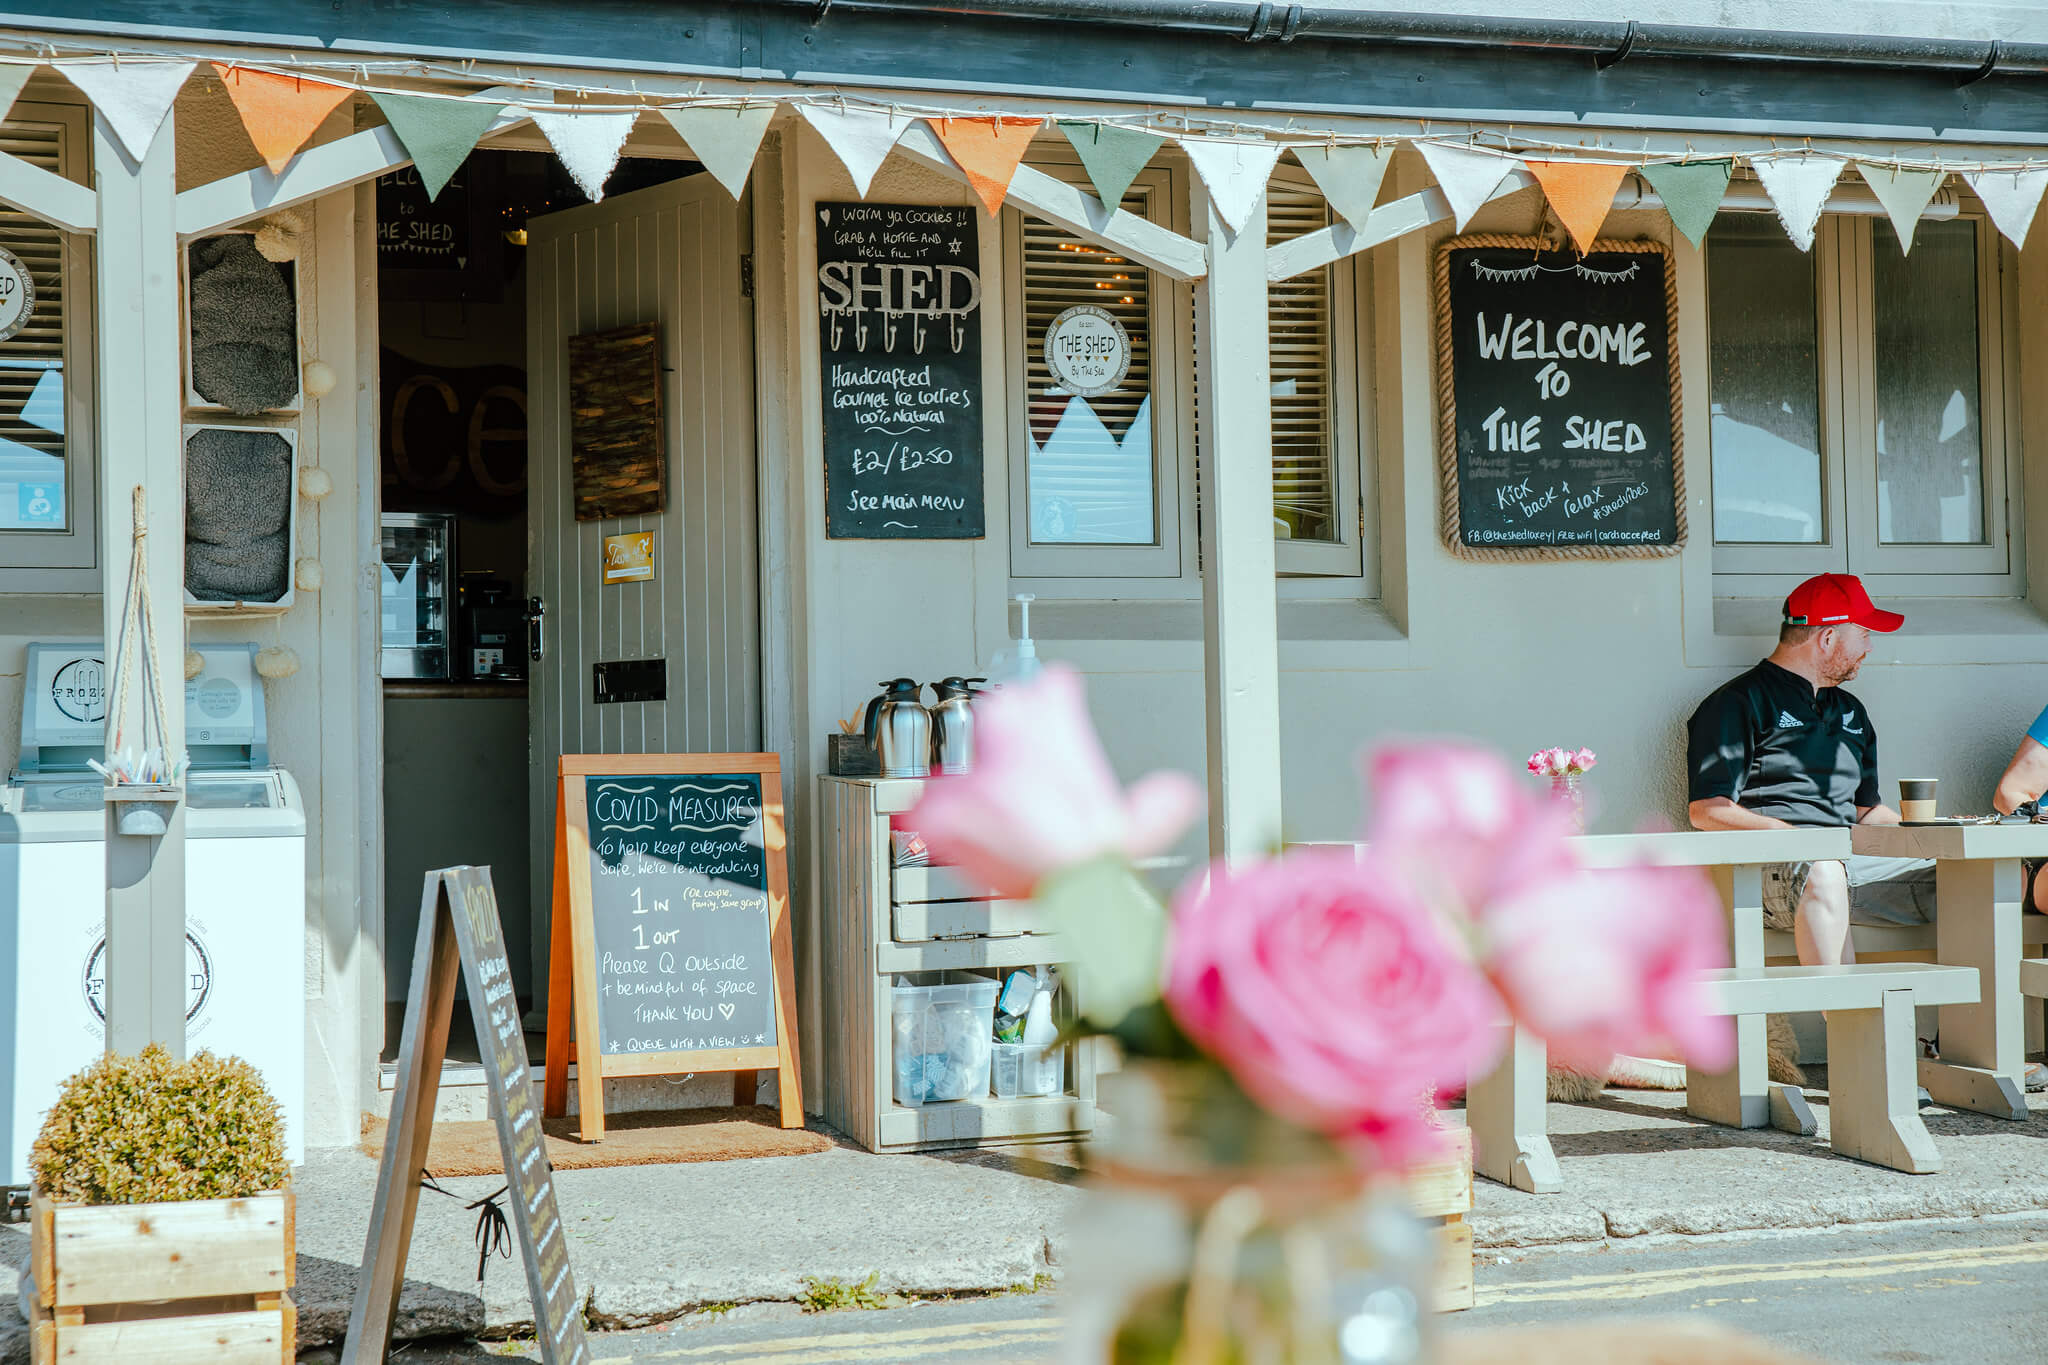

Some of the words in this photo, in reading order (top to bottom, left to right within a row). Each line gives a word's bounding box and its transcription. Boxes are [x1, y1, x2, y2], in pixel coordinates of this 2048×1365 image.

[401, 202, 414, 215] to
[886, 212, 903, 227] ya
[906, 210, 952, 223] Cockles
[408, 221, 452, 240] SHED
[834, 230, 864, 245] GRAB
[869, 233, 876, 243] A
[883, 232, 919, 244] HOTTIE
[921, 233, 942, 244] AND
[819, 261, 981, 314] SHED
[1059, 334, 1082, 353] THE
[1085, 334, 1115, 353] SHED
[1477, 312, 1652, 366] WELCOME
[832, 365, 930, 389] Handcrafted
[1535, 362, 1570, 400] TO
[833, 390, 889, 408] Gourmet
[895, 391, 916, 406] Ice
[855, 409, 891, 424] 100%
[893, 411, 944, 423] Natural
[1482, 406, 1541, 453] THE
[1562, 415, 1647, 453] SHED
[847, 490, 879, 511] See
[882, 493, 918, 510] Main
[921, 495, 965, 511] Menu
[1497, 477, 1534, 510] Kick
[1520, 487, 1558, 518] back
[1563, 486, 1604, 518] relax
[1592, 482, 1648, 520] #shedvibes
[1620, 530, 1660, 543] accepted
[596, 792, 658, 822] COVID
[669, 796, 758, 824] MEASURES
[597, 837, 613, 856] To
[618, 837, 649, 861] help
[690, 839, 748, 859] everyone
[630, 887, 648, 914] 1
[654, 900, 670, 911] IN
[632, 924, 650, 950] 1
[653, 929, 680, 945] OUT
[602, 952, 649, 974] Please
[659, 951, 677, 974] Q
[685, 953, 748, 972] Outside
[617, 979, 633, 995] be
[692, 979, 706, 997] of
[715, 980, 757, 998] space
[633, 1003, 679, 1023] THANK
[683, 1006, 713, 1021] YOU
[627, 1038, 666, 1051] QUEUE
[670, 1038, 693, 1049] WITH
[699, 1037, 707, 1047] A
[709, 1036, 735, 1046] VIEW
